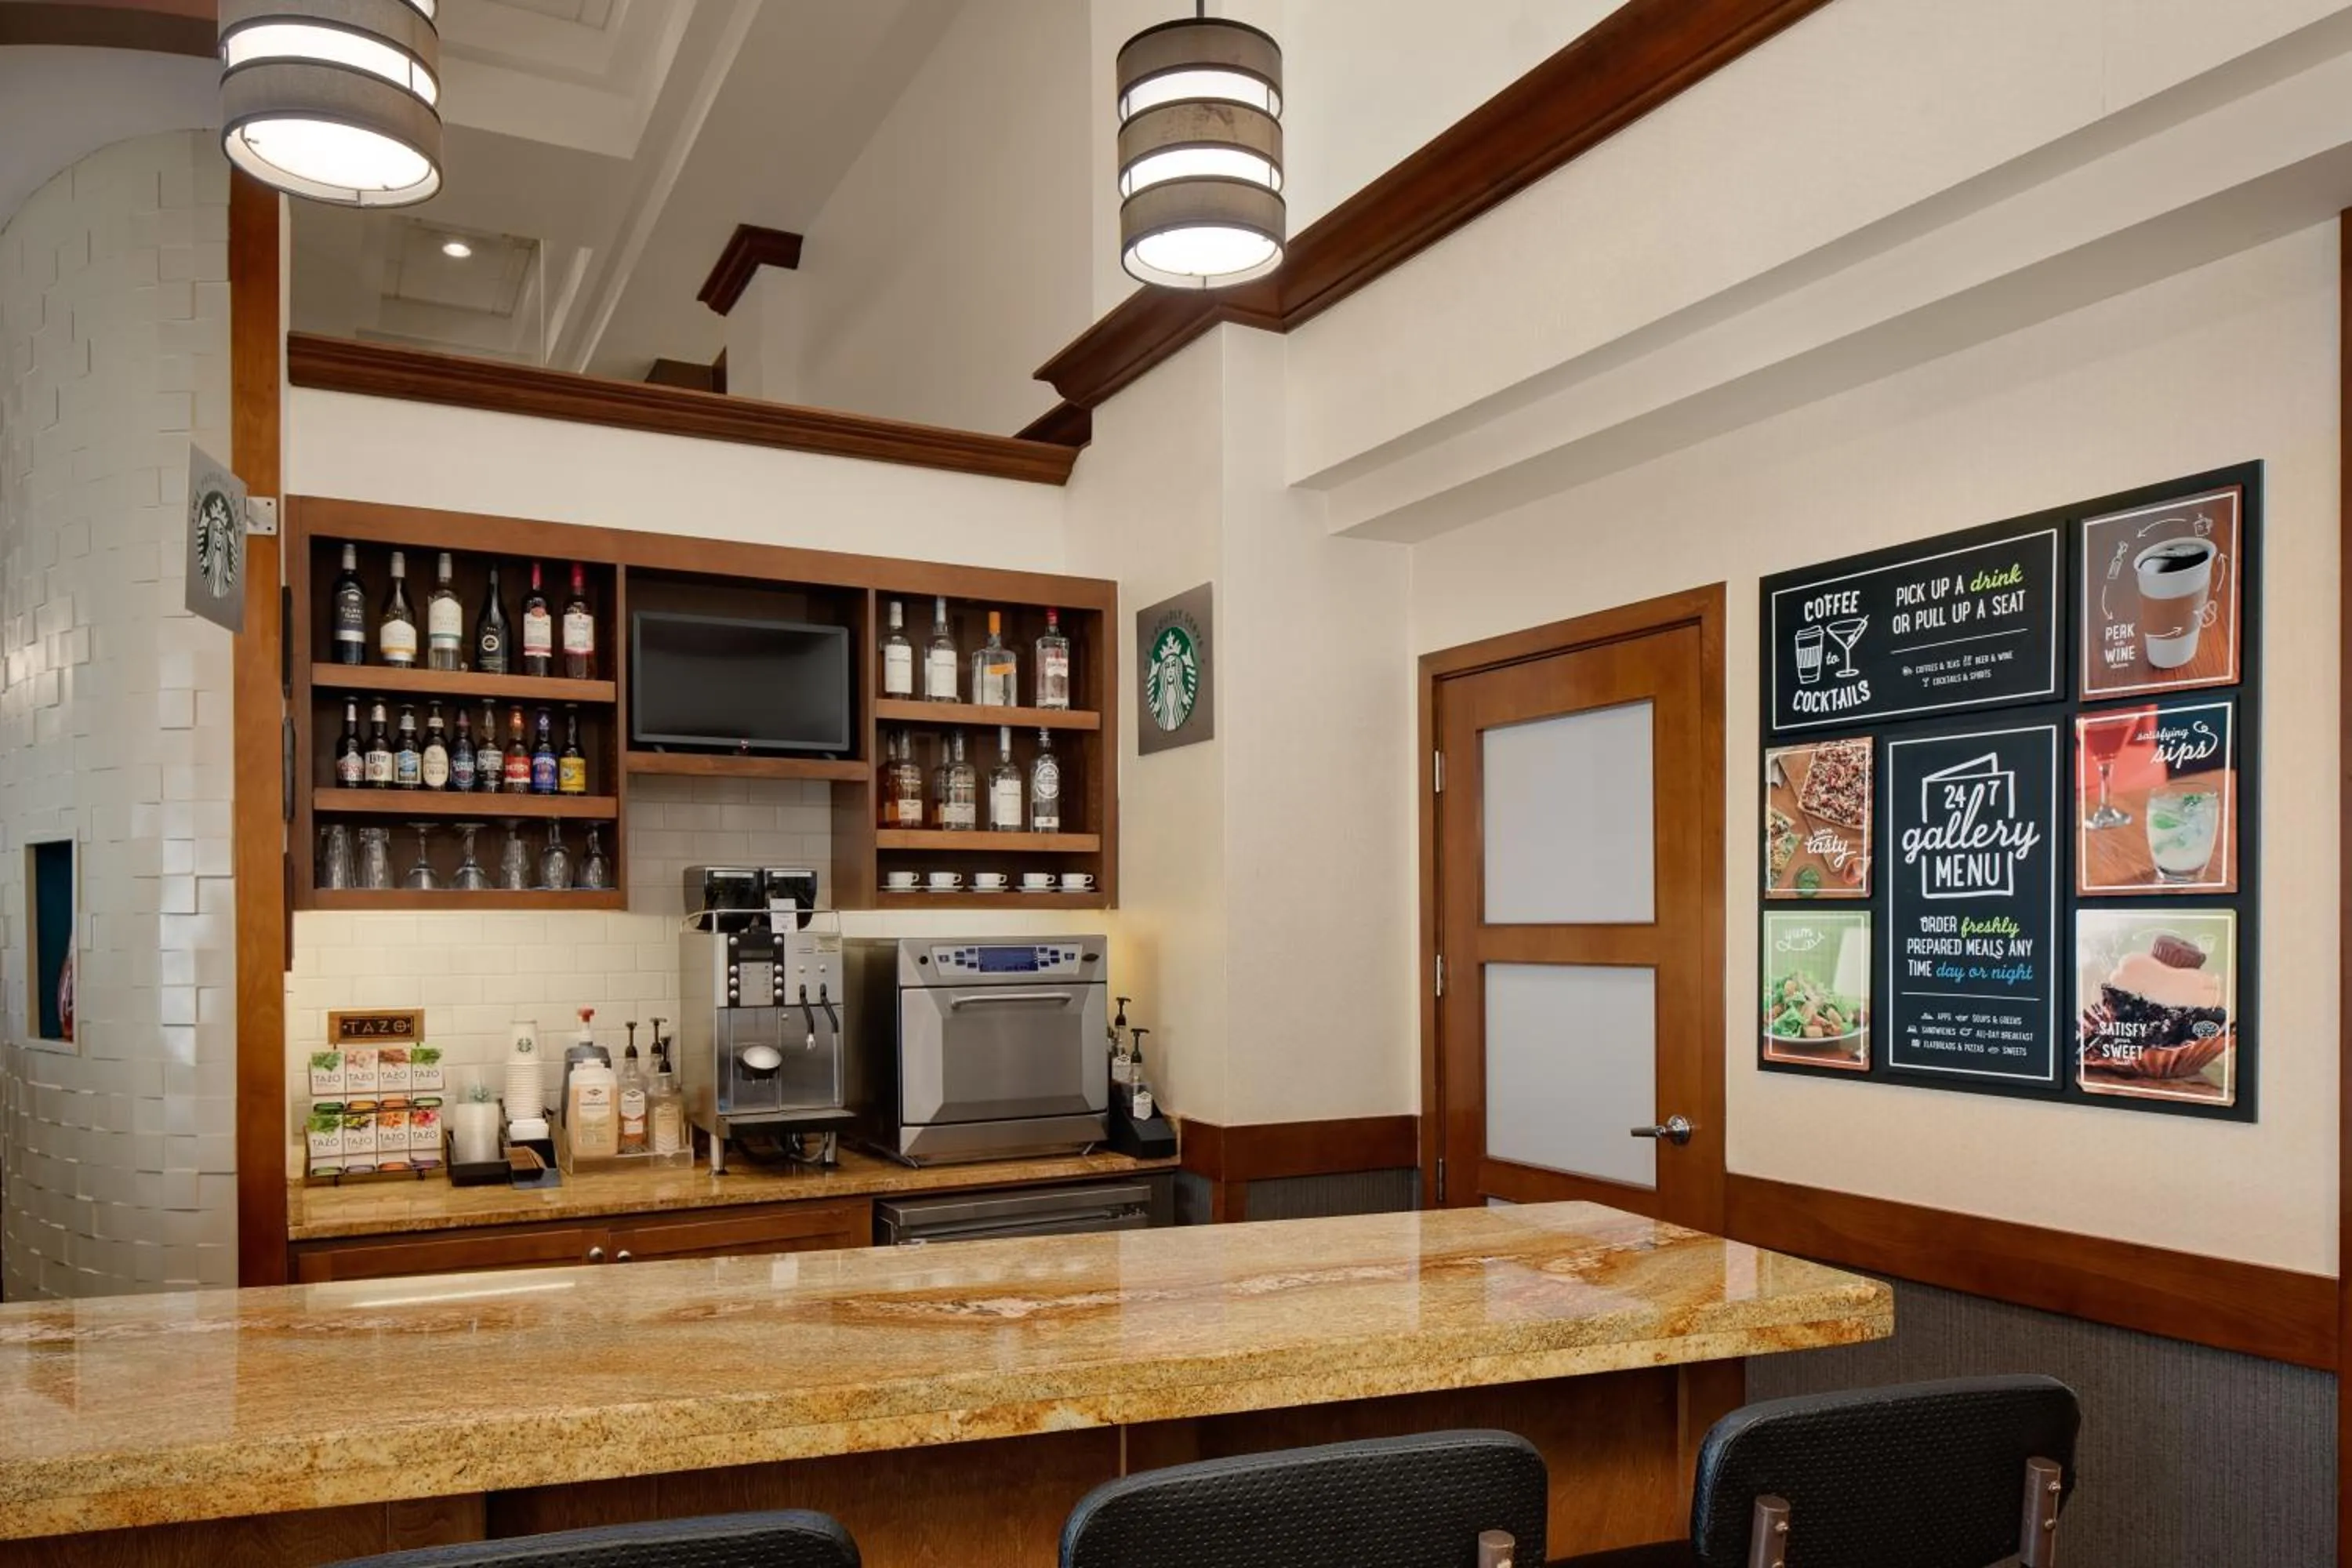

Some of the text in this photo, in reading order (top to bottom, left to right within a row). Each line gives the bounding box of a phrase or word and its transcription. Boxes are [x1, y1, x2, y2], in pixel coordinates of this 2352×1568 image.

[1896, 563, 2024, 607] PICK UP A drink
[1804, 590, 1860, 622] COFFEE
[1893, 590, 2026, 634] OR PULL UP A SEAT
[1826, 652, 1840, 665] to
[2105, 645, 2136, 662] WINE
[1793, 680, 1871, 712] COCKTAILS
[2136, 728, 2189, 741] satisfying
[2150, 735, 2216, 769] sips
[1944, 784, 1966, 809] 24
[1987, 780, 2001, 806] 7
[1902, 783, 2040, 864] gallery
[1804, 835, 1857, 868] tasty
[1936, 853, 2000, 887] MENU
[1920, 916, 2020, 938] ORDER freshly
[1907, 938, 2033, 959] PREPARED MEALS ANY
[1907, 959, 2033, 985] TIME day or night
[347, 1020, 407, 1034] TAZO
[2099, 1022, 2147, 1037] SATISFY
[2102, 1044, 2143, 1060] SWEET
[347, 1073, 374, 1081] TAZO
[381, 1070, 407, 1080] TAZO
[414, 1069, 439, 1078] TAZO
[312, 1138, 339, 1147] TAZO
[344, 1137, 372, 1145] TAZO
[379, 1133, 405, 1142] TAZO
[412, 1131, 437, 1139] TAZO
